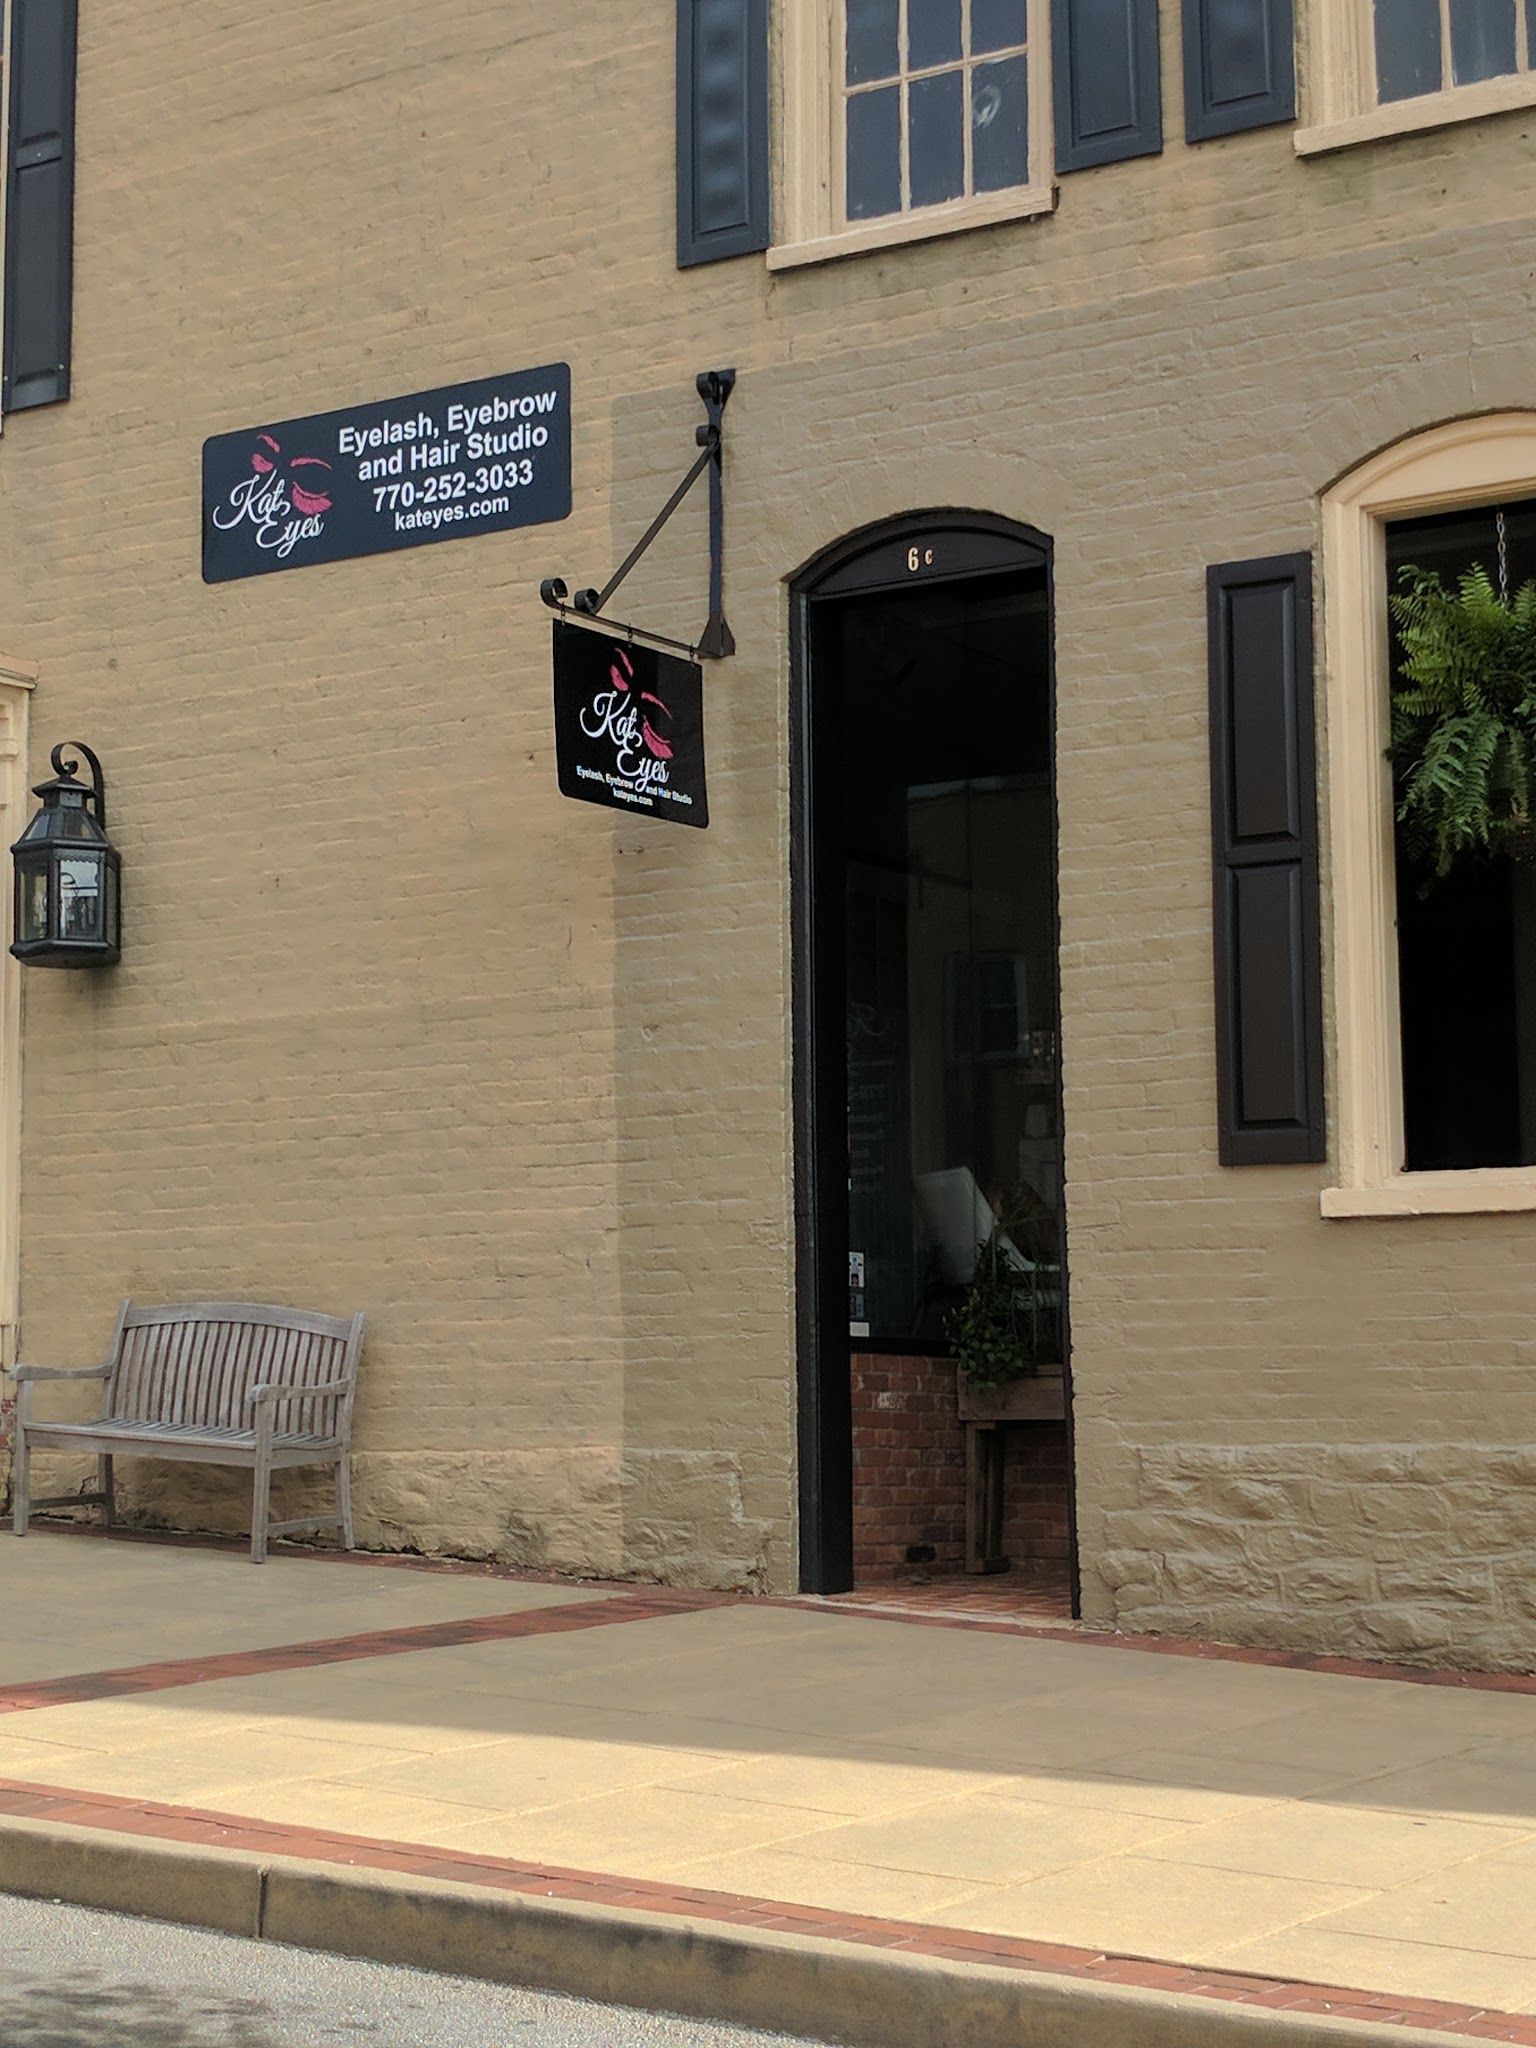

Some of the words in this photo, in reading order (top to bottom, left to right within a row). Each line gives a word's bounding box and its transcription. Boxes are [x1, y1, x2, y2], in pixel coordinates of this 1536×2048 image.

[339, 412, 439, 457] Eyelash,
[448, 390, 557, 432] Eyebrow
[358, 448, 406, 482] and
[410, 437, 460, 471] Hair
[467, 423, 548, 460] Studio
[213, 469, 291, 530] Kat
[373, 458, 534, 512] 770-252-3033
[394, 496, 510, 532] kateyes.com
[256, 501, 325, 558] Eyes
[579, 690, 643, 746] Kat
[616, 731, 670, 792] Eyes
